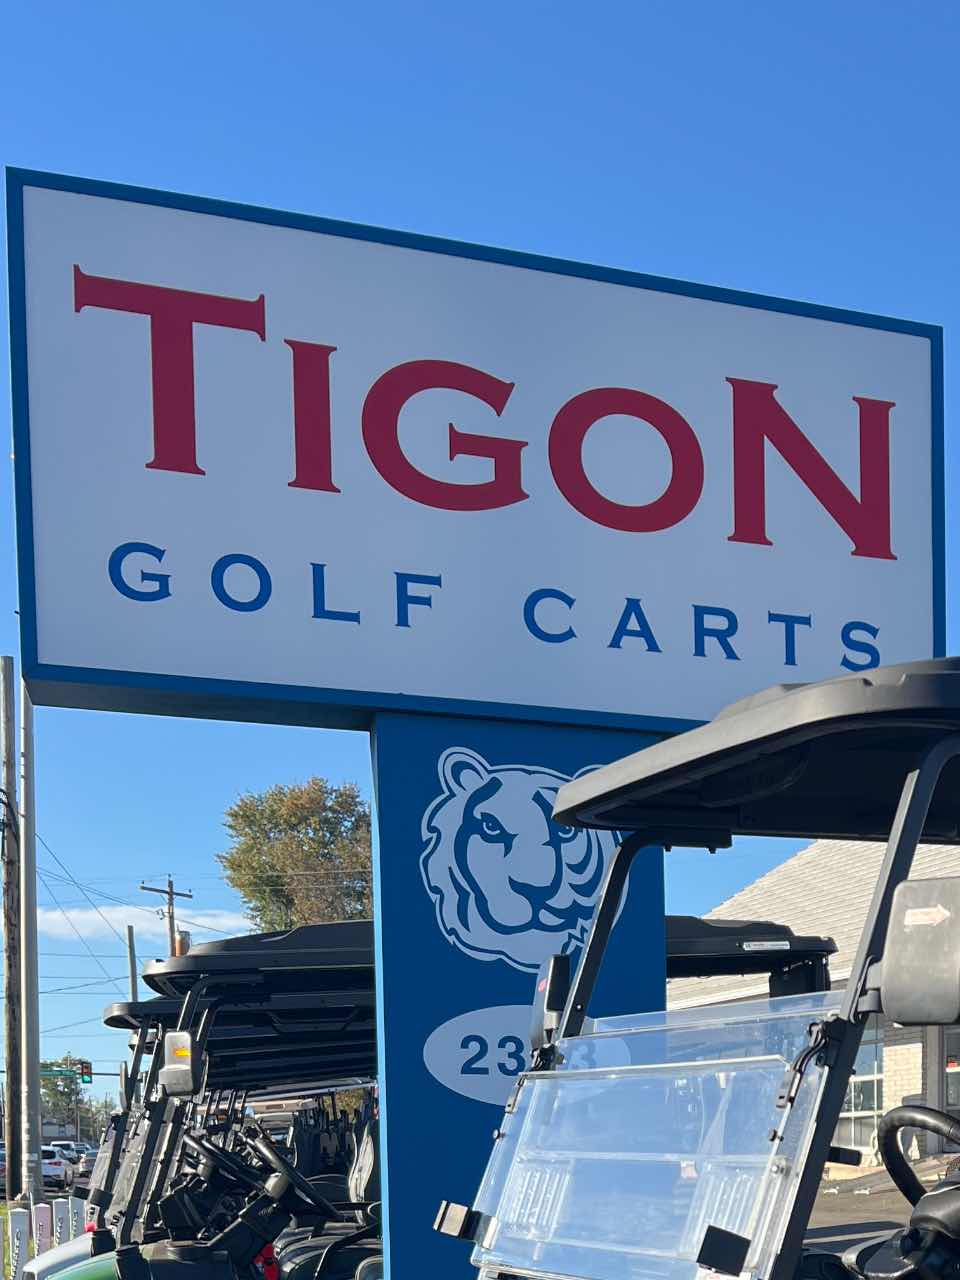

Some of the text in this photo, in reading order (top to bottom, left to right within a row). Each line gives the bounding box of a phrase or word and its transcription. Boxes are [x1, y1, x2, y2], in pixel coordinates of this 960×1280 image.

[74, 264, 897, 561] TIGON
[108, 542, 881, 672] GOLF CARTS
[459, 1034, 598, 1077] 233
